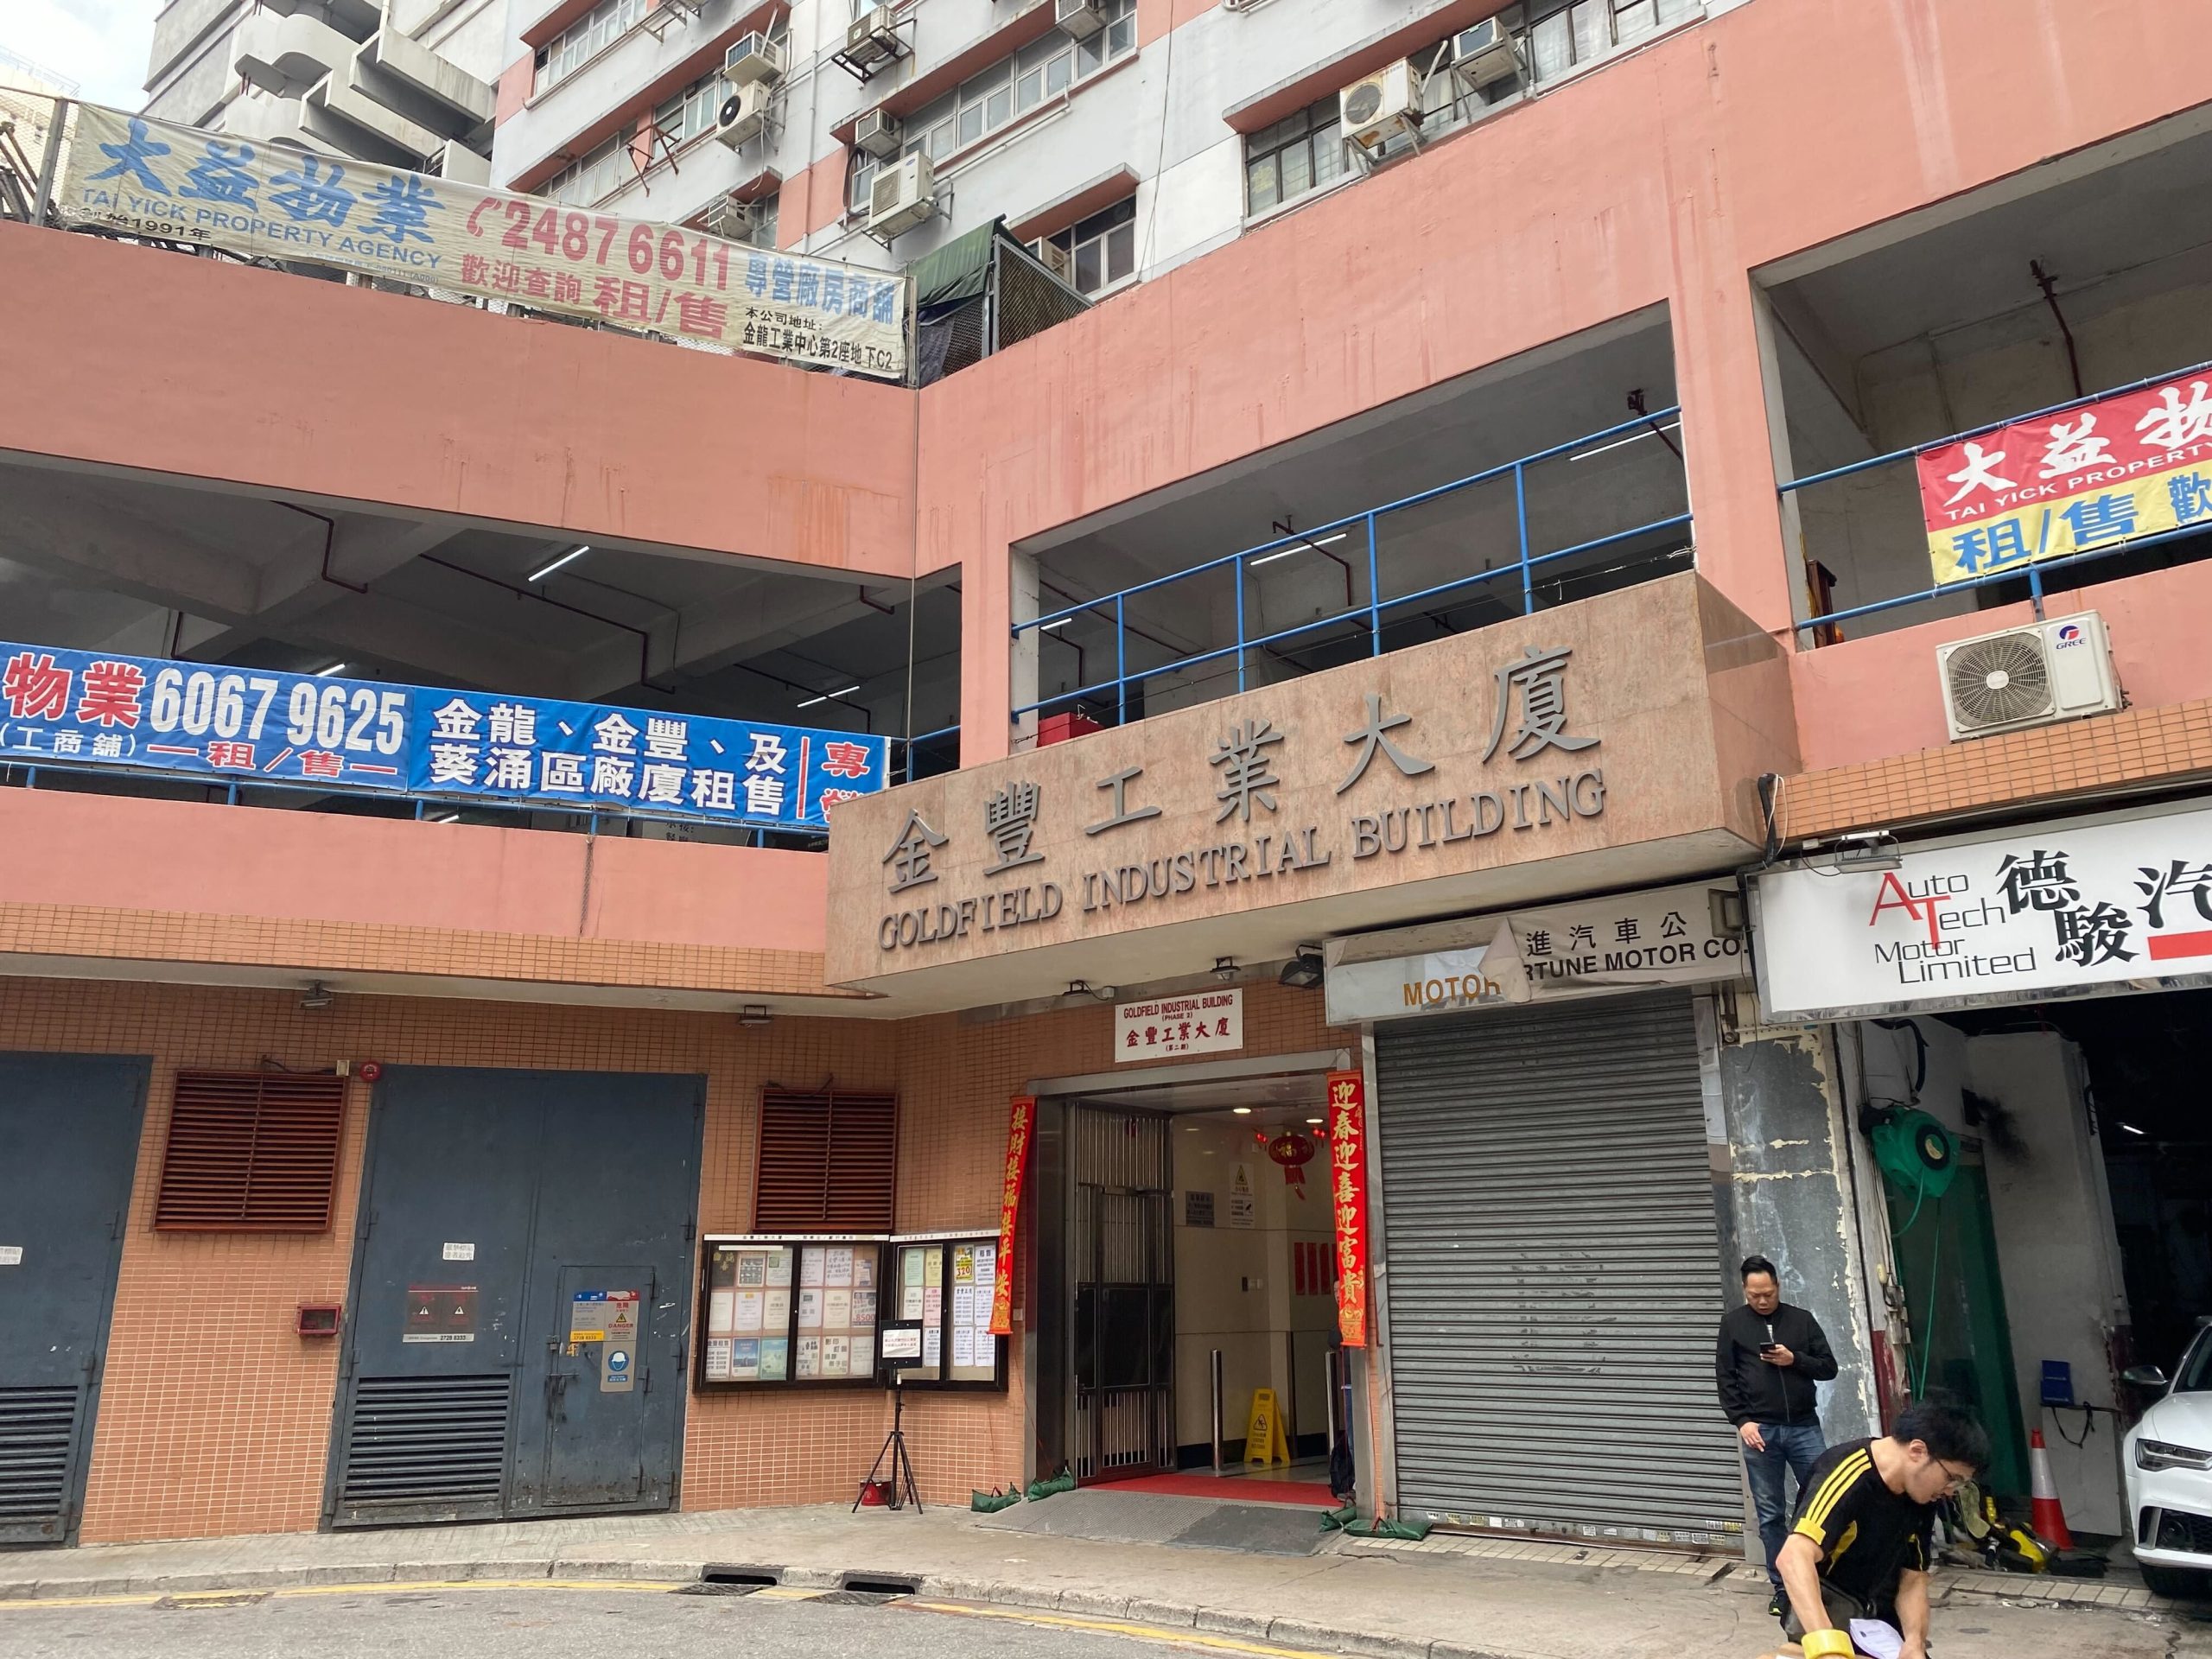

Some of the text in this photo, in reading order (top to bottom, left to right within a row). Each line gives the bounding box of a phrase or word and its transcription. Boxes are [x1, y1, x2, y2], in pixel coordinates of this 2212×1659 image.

[86, 117, 447, 244] 大益物業
[82, 188, 118, 213] TAI
[129, 195, 187, 221] YICK
[196, 208, 332, 249] PROPERTY
[339, 237, 442, 269] AGENCY
[501, 200, 729, 291] 2487 6611
[461, 253, 728, 340] 歡迎查詢 租/售
[743, 321, 893, 370] 金龍工業中心第2座地下C2
[1945, 500, 1986, 522] TAI
[1994, 482, 2058, 508] YICK
[1953, 493, 2139, 575] 租/售
[2056, 637, 2087, 650] GREE
[3, 652, 407, 756] 物業 6067 9625
[429, 743, 785, 816] 葵涌區廠廈租售
[882, 645, 1601, 894] 金豐工業大廈
[879, 768, 1605, 951] GOLDFIELD INDUSTRIAL BUILDING
[1869, 872, 1969, 927] Auto
[1908, 895, 2006, 950] Tech
[1605, 942, 1696, 972] MOTOR
[1703, 936, 1749, 959] CO.
[1874, 938, 1966, 964] Motor
[1897, 947, 2037, 984] Limited
[1123, 994, 1233, 1019] GOLDFIELD INDUSTRIAL BUILDING
[1127, 1017, 1230, 1047] 金豐工業大廈
[1162, 1013, 1184, 1022] (PHASE
[995, 1105, 1029, 1297] 接財接福接平安
[1332, 1081, 1361, 1304] 迎春迎喜迎富貴
